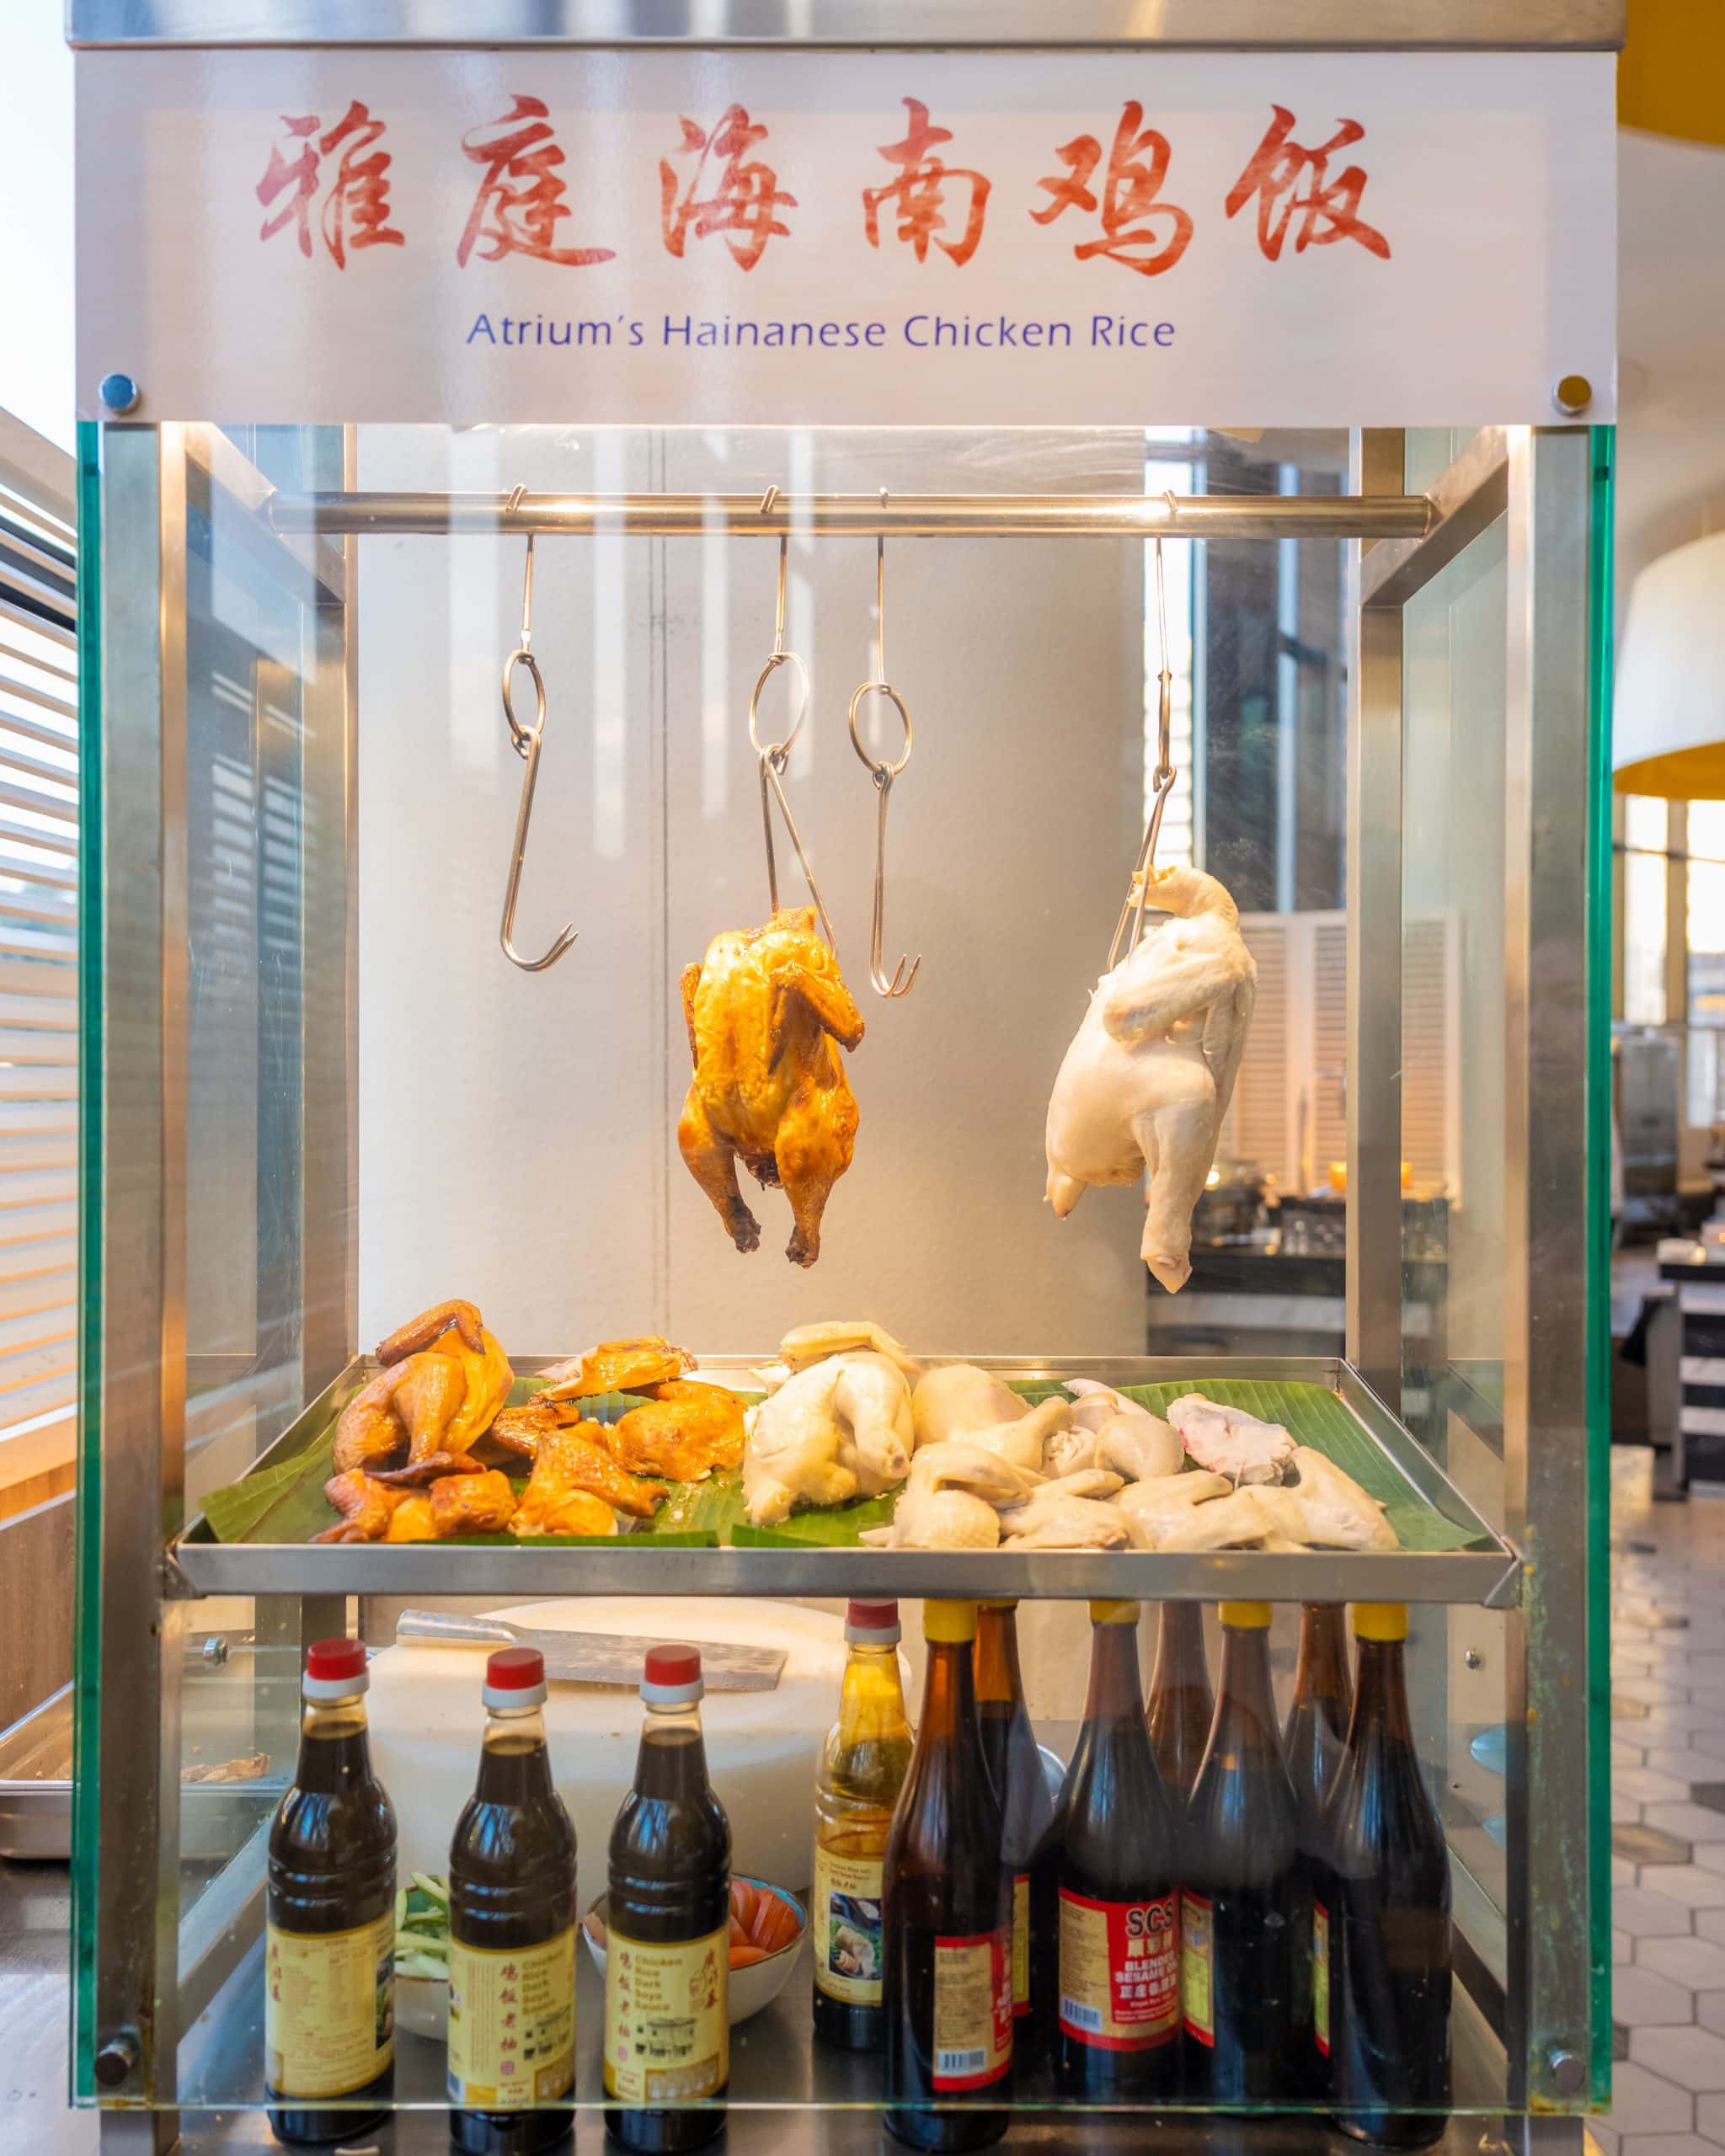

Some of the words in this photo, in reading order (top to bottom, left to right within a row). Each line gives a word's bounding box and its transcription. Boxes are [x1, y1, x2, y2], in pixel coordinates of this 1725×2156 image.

[259, 94, 1392, 277] 雅庭海南鸡饭
[466, 312, 644, 346] Atrium's
[663, 315, 887, 346] Hainanese
[904, 315, 1071, 346] Chicken
[1091, 315, 1176, 346] Rice
